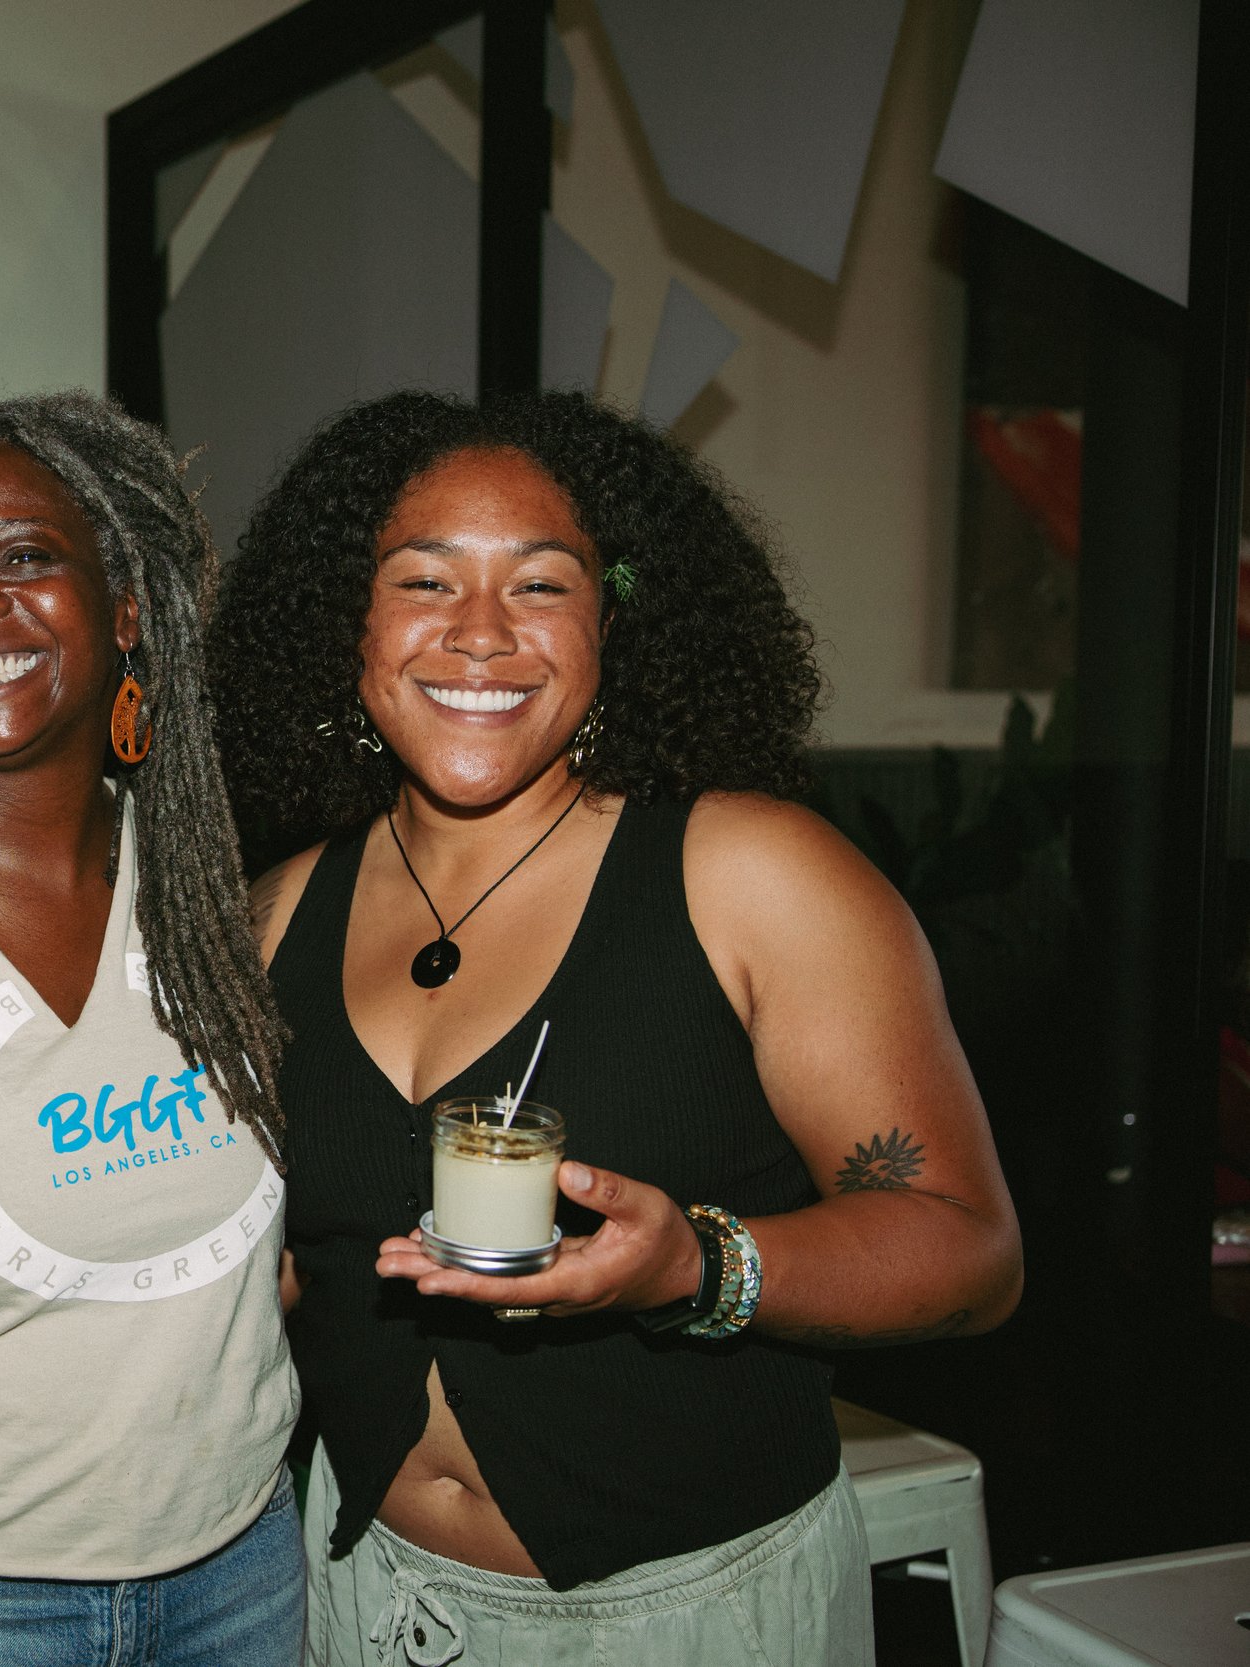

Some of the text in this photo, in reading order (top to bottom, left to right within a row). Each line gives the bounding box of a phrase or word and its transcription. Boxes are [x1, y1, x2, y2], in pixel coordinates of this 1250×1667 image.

[52, 1132, 237, 1188] LOS ANGELES, CA
[133, 1184, 279, 1290] GREEN
